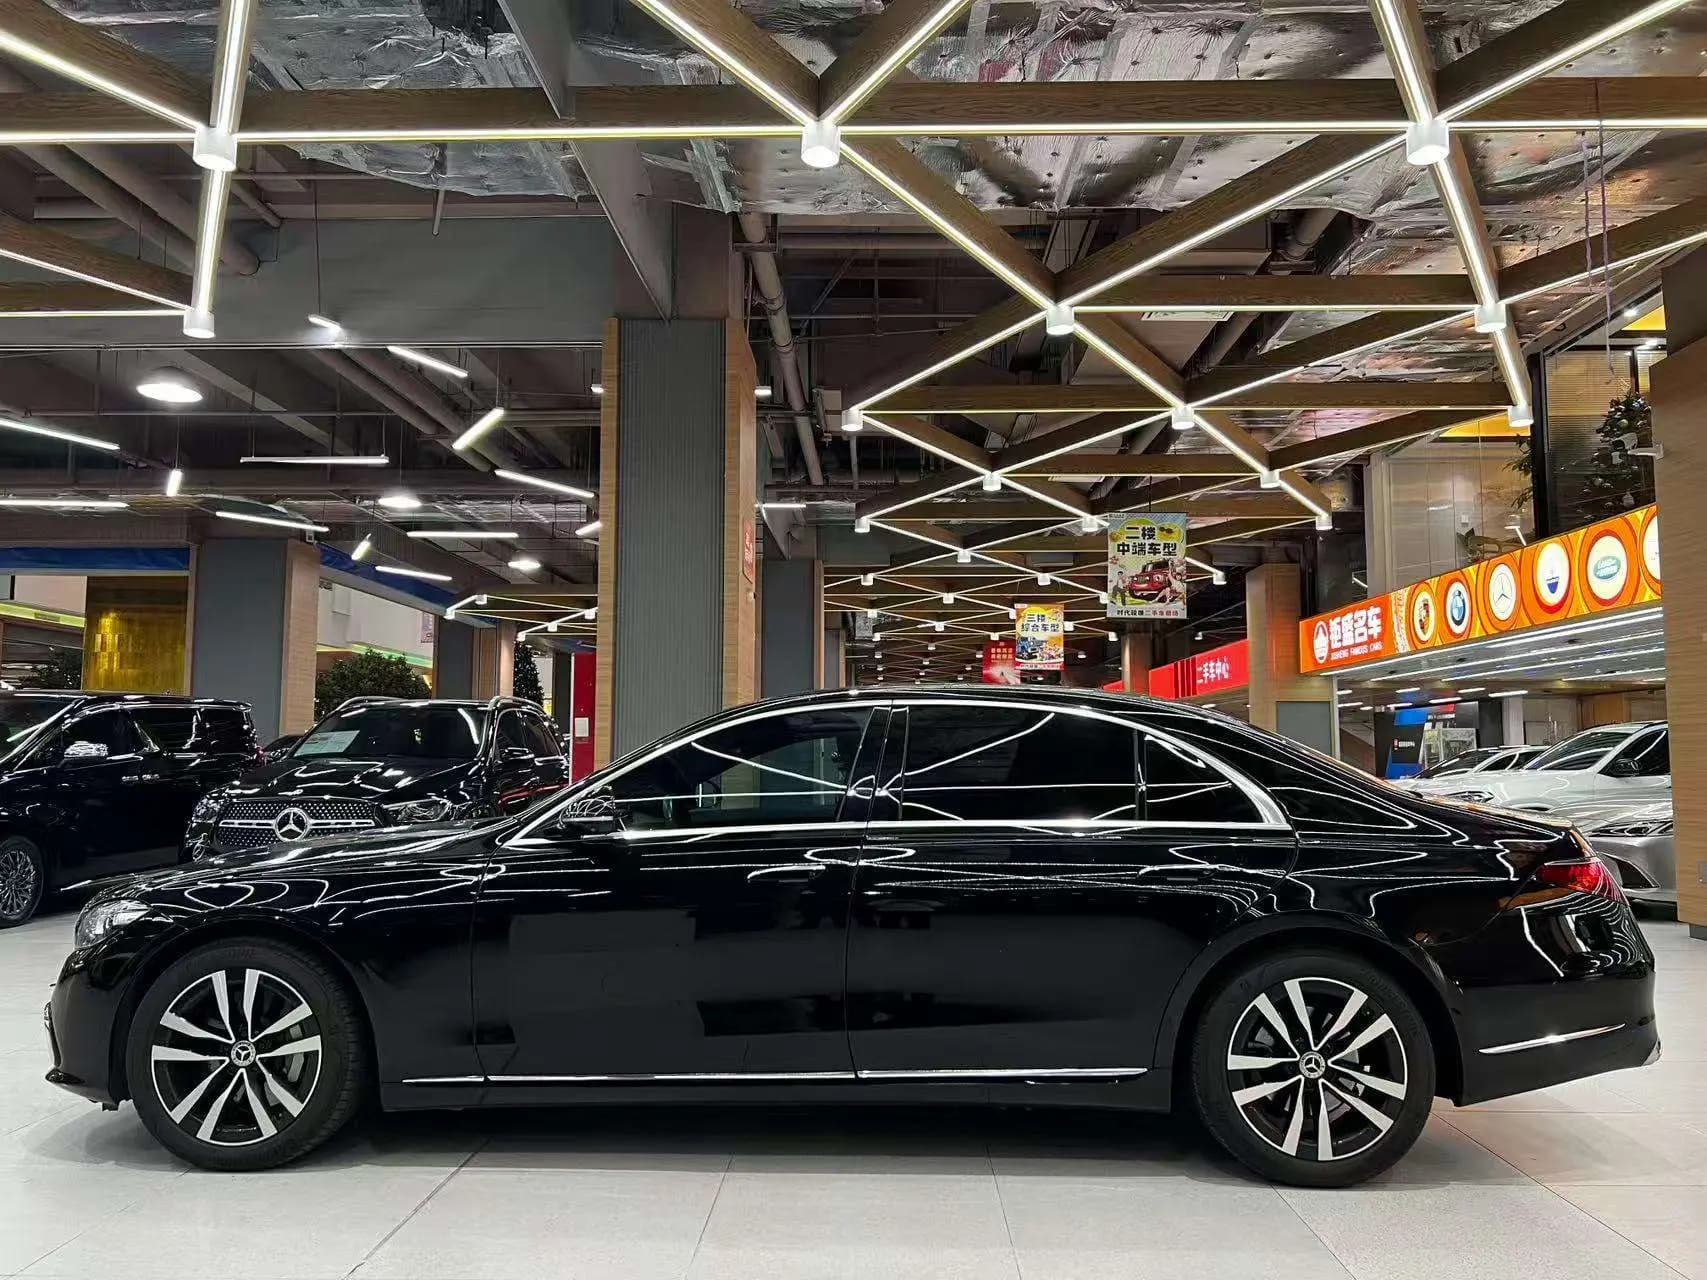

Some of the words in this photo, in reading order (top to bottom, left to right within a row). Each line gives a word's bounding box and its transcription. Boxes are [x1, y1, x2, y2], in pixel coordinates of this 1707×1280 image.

[1125, 526, 1156, 541] 二楼
[1116, 541, 1178, 557] 中端车型
[1020, 623, 1060, 633] 综合车型
[1369, 640, 1384, 652] CARS
[1196, 655, 1230, 684] 二手车中心
